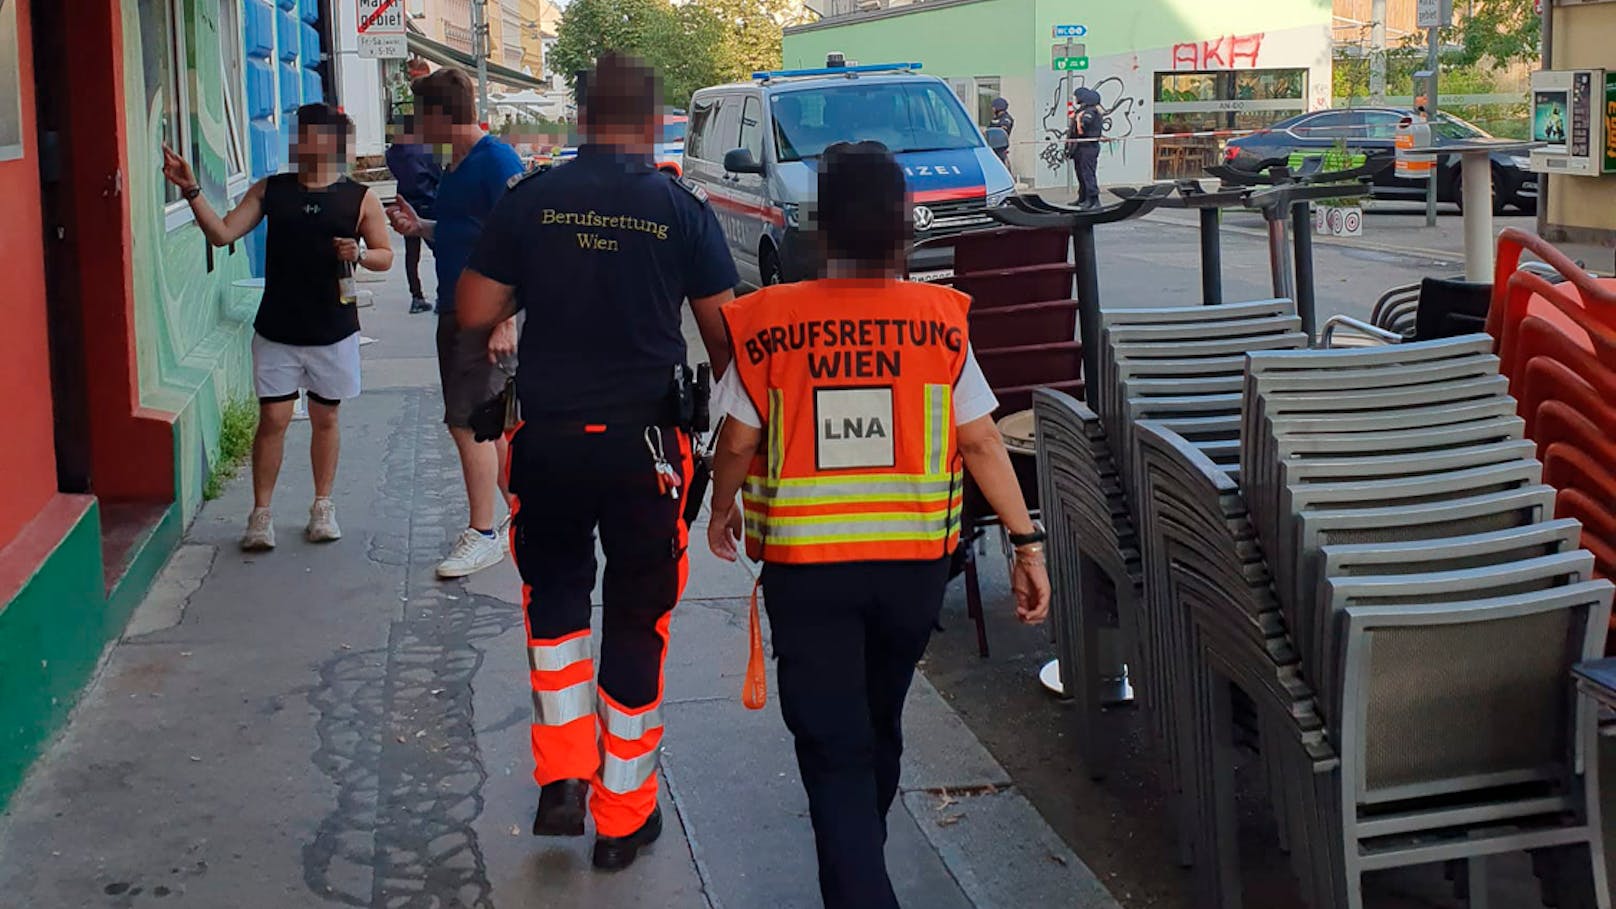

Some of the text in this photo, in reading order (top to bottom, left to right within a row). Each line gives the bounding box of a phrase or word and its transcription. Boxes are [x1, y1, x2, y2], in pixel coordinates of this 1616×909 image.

[361, 11, 401, 28] gebiet
[1173, 32, 1264, 71] AKA
[905, 165, 961, 176] IZEI
[542, 208, 669, 240] Berufsrettung
[577, 232, 618, 251] Wien
[745, 319, 962, 366] BERUFSRETTUNG
[808, 351, 901, 379] WIEN
[824, 417, 886, 440] LNA
